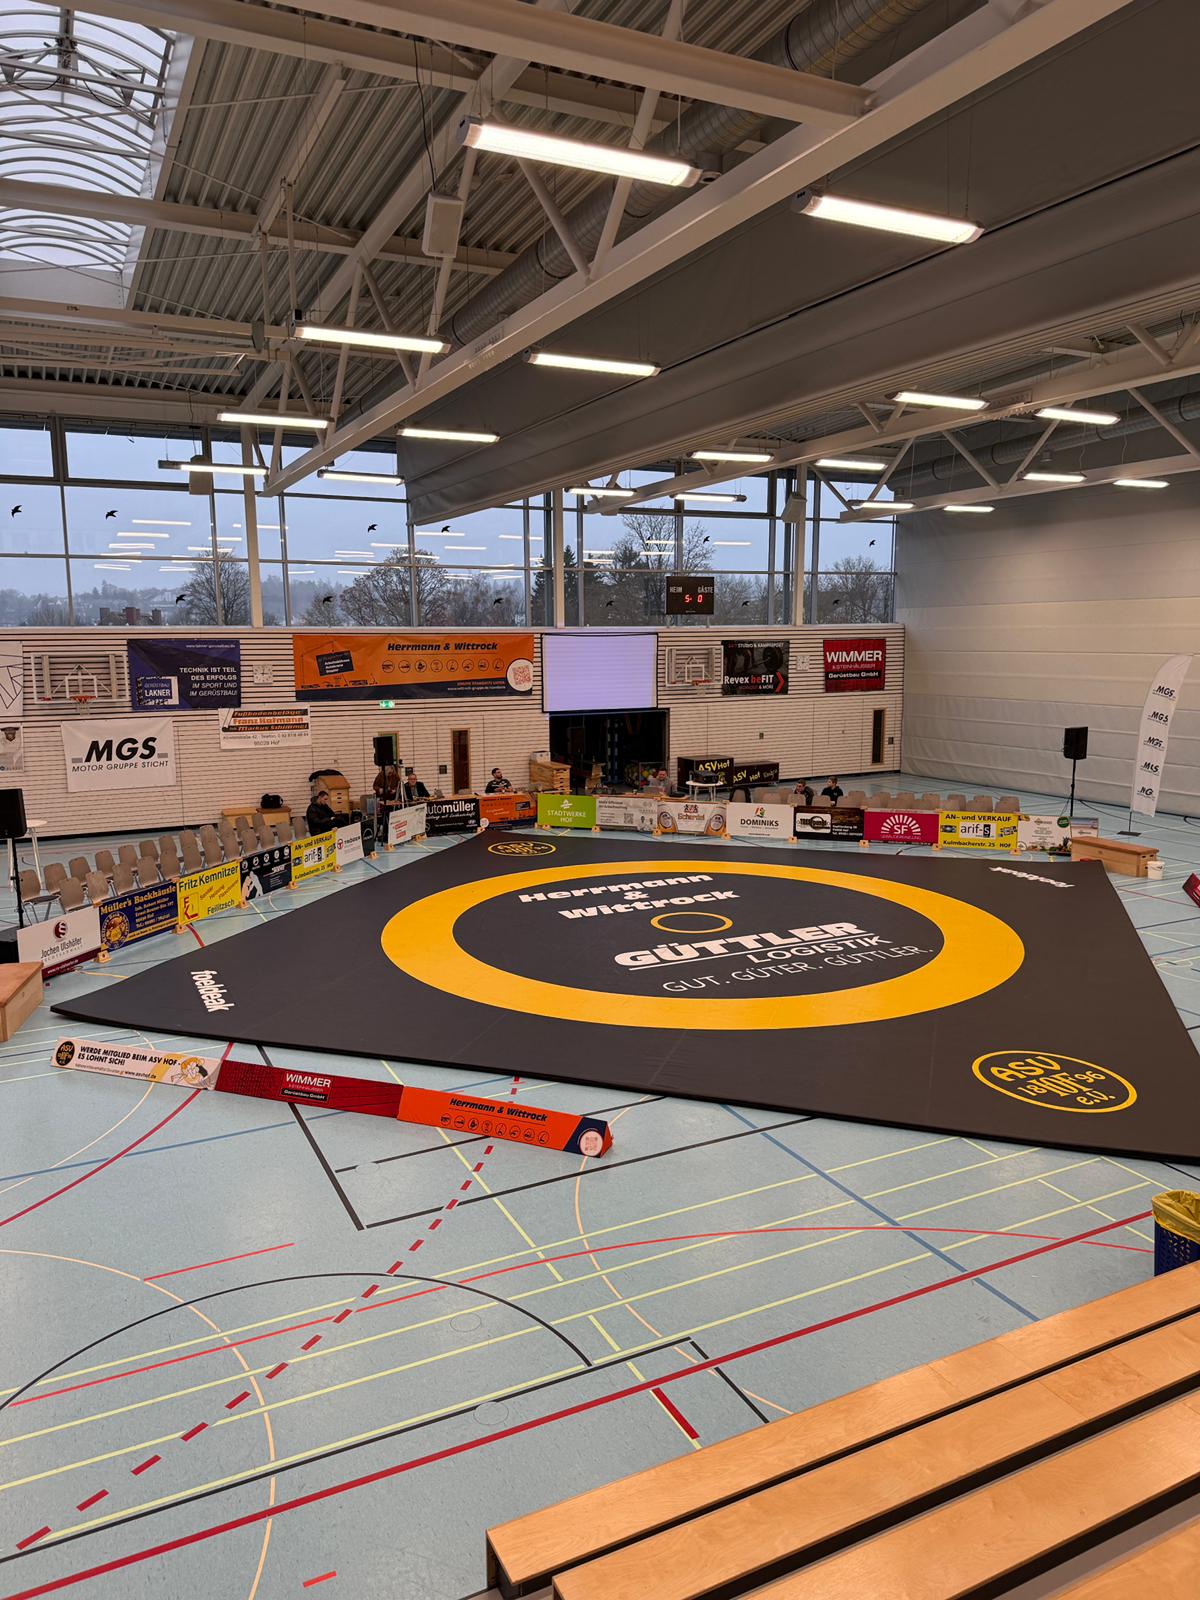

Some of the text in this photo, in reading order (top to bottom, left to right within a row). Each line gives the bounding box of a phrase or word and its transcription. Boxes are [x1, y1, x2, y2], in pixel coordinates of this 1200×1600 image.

[697, 594, 702, 602] 0
[388, 642, 440, 651] Herrmann
[454, 642, 498, 650] Wittrock
[826, 650, 882, 662] WIMMER
[724, 676, 750, 684] Revex
[1156, 686, 1175, 697] MGS
[1151, 711, 1168, 722] MGS
[84, 737, 157, 762] MGS
[72, 764, 103, 772] MOTOR
[698, 761, 717, 771] ASV
[733, 770, 747, 783] ASV
[740, 818, 779, 827] DOMINIKS
[894, 825, 908, 834] SF
[314, 834, 332, 845] VERKAUF
[179, 865, 238, 892] Fritz Kemnitzer
[518, 874, 713, 904] Herrmann
[101, 885, 176, 915] Müller's Backhäusle
[624, 891, 652, 901] &
[558, 890, 741, 920] Wittrock
[614, 922, 868, 967] GÜTTLER
[746, 935, 893, 964] LOGISTIK
[41, 946, 59, 958] Jochen
[662, 945, 934, 992] GUT. GÜTER. GÜTTLER.
[191, 970, 234, 1012] foeldeak
[80, 1046, 101, 1054] WERDE
[102, 1049, 131, 1059] MITGLIED
[132, 1053, 147, 1061] BEIM
[86, 1054, 106, 1063] LOHNT
[108, 1058, 126, 1066] SICH!
[990, 1056, 1061, 1082] ASV
[286, 1073, 331, 1088] WIMMER
[450, 1098, 495, 1112] Herrmann
[506, 1108, 547, 1122] Wittrock
